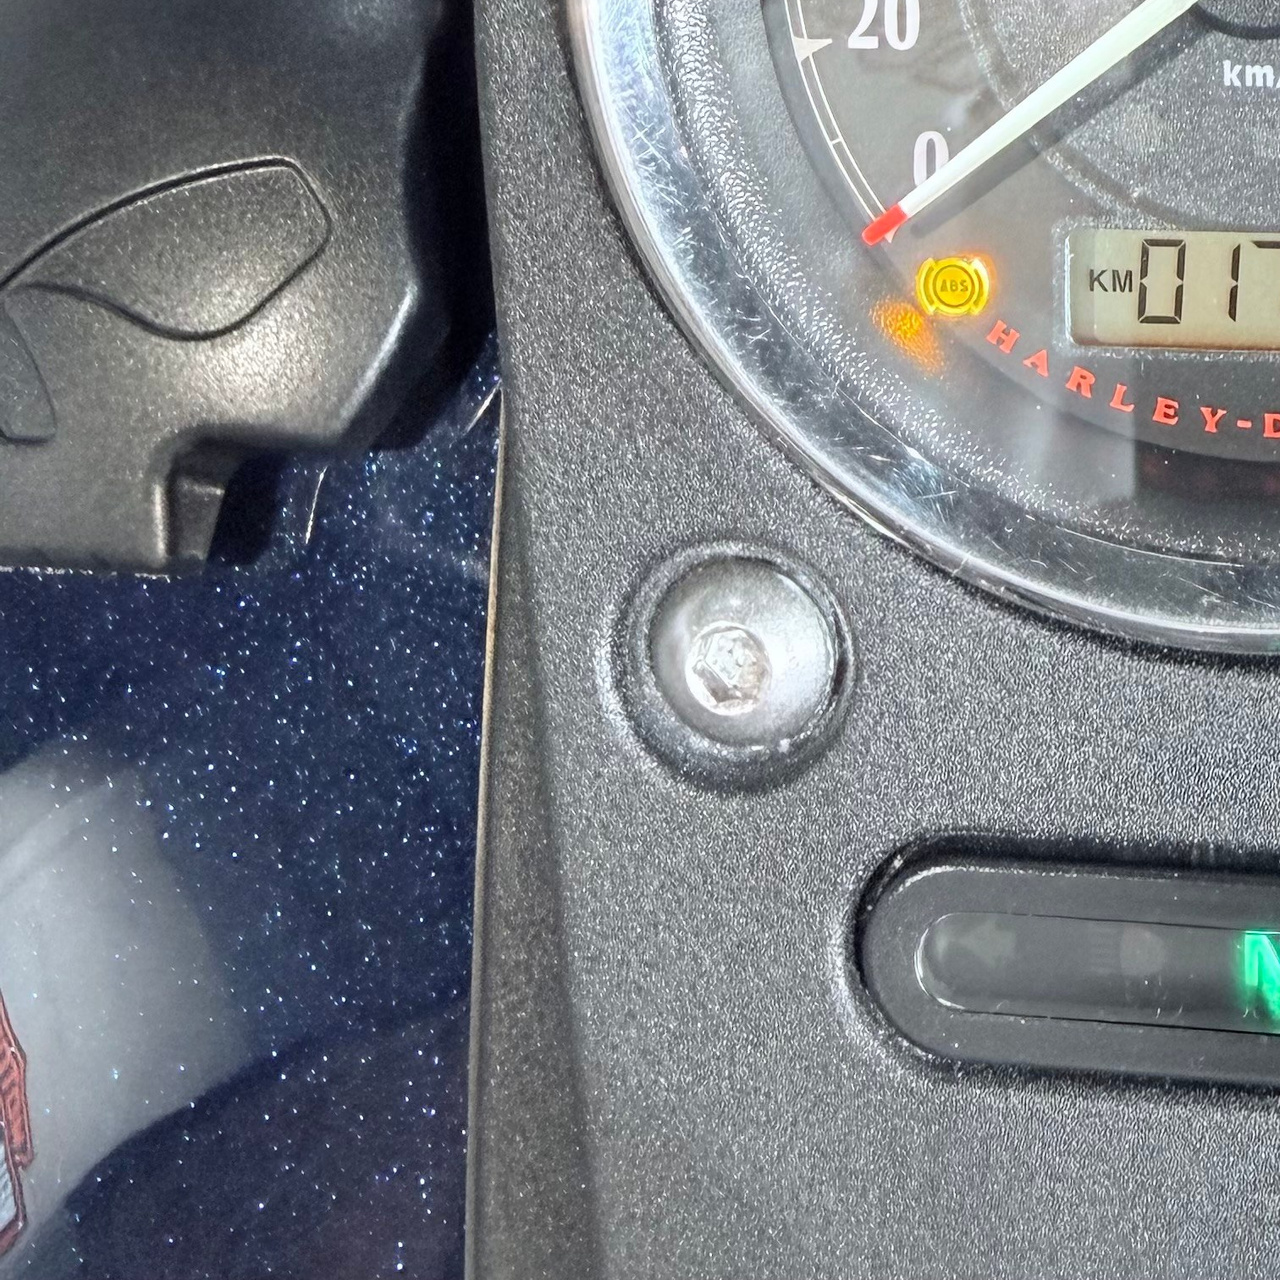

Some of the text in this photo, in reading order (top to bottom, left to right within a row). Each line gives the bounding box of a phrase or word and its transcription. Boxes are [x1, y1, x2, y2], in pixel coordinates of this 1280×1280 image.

[912, 130, 950, 187] 0
[939, 278, 969, 293] ABS
[1088, 268, 1134, 294] KM
